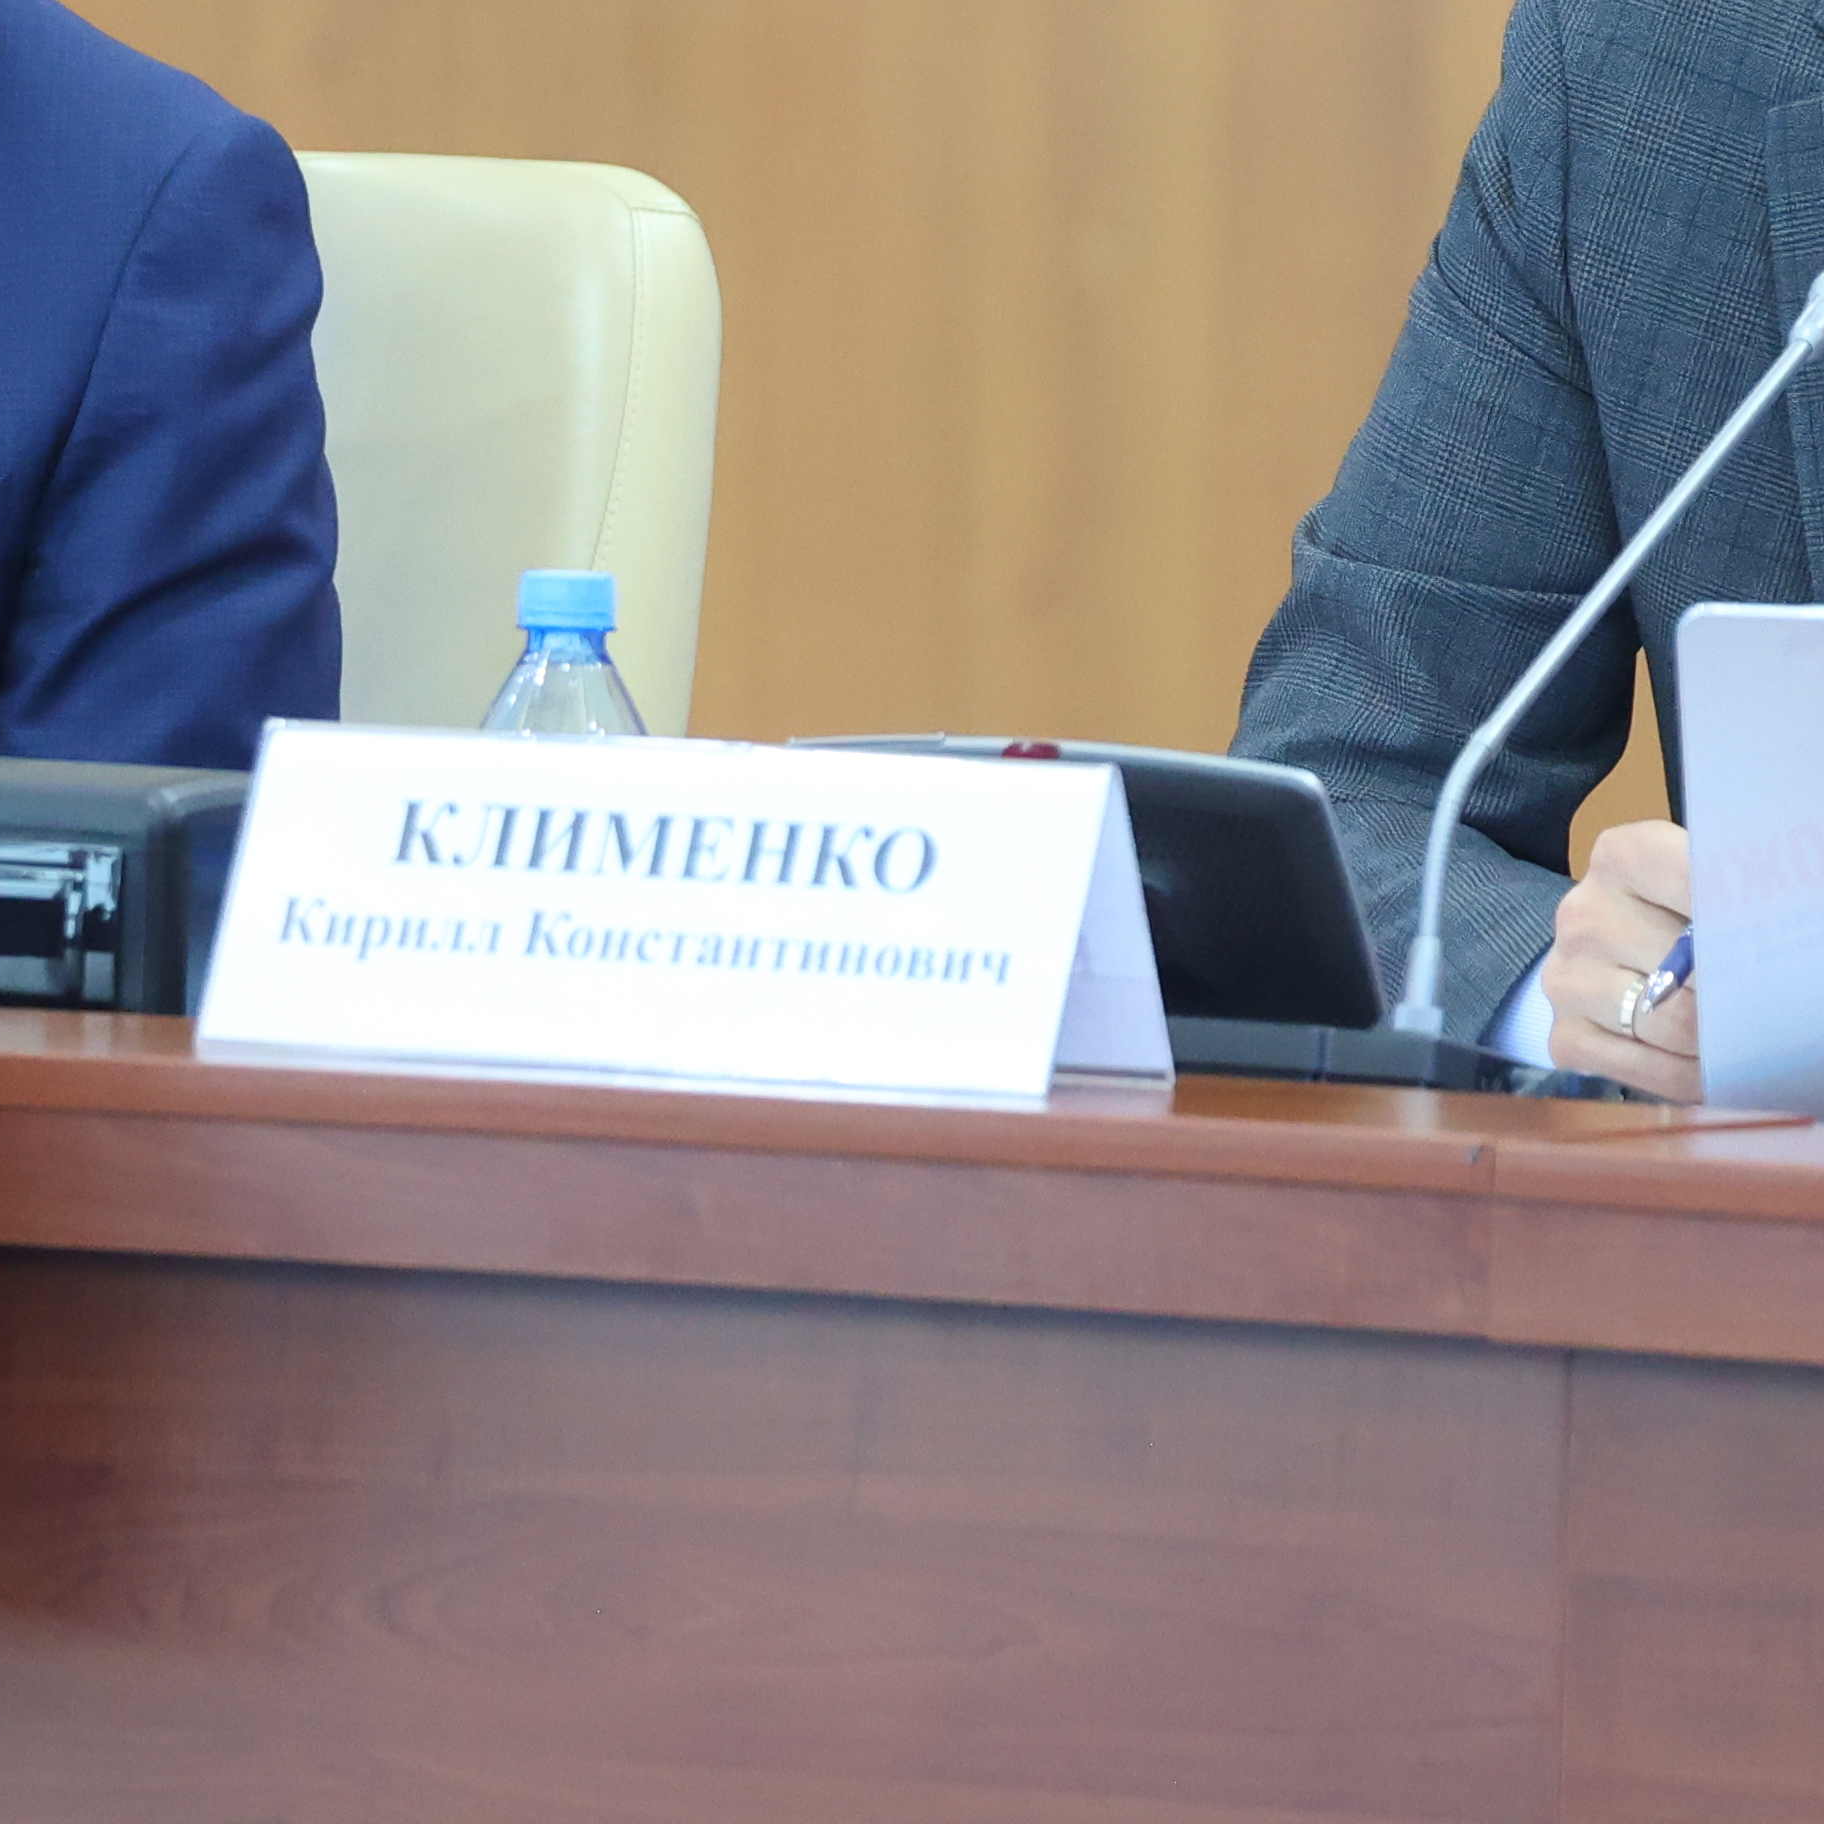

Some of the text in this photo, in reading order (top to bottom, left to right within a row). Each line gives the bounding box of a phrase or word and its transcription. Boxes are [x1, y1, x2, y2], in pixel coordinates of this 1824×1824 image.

[392, 798, 940, 895] КЛИМЕНКО
[279, 896, 1012, 985] Кирилл Константинович
